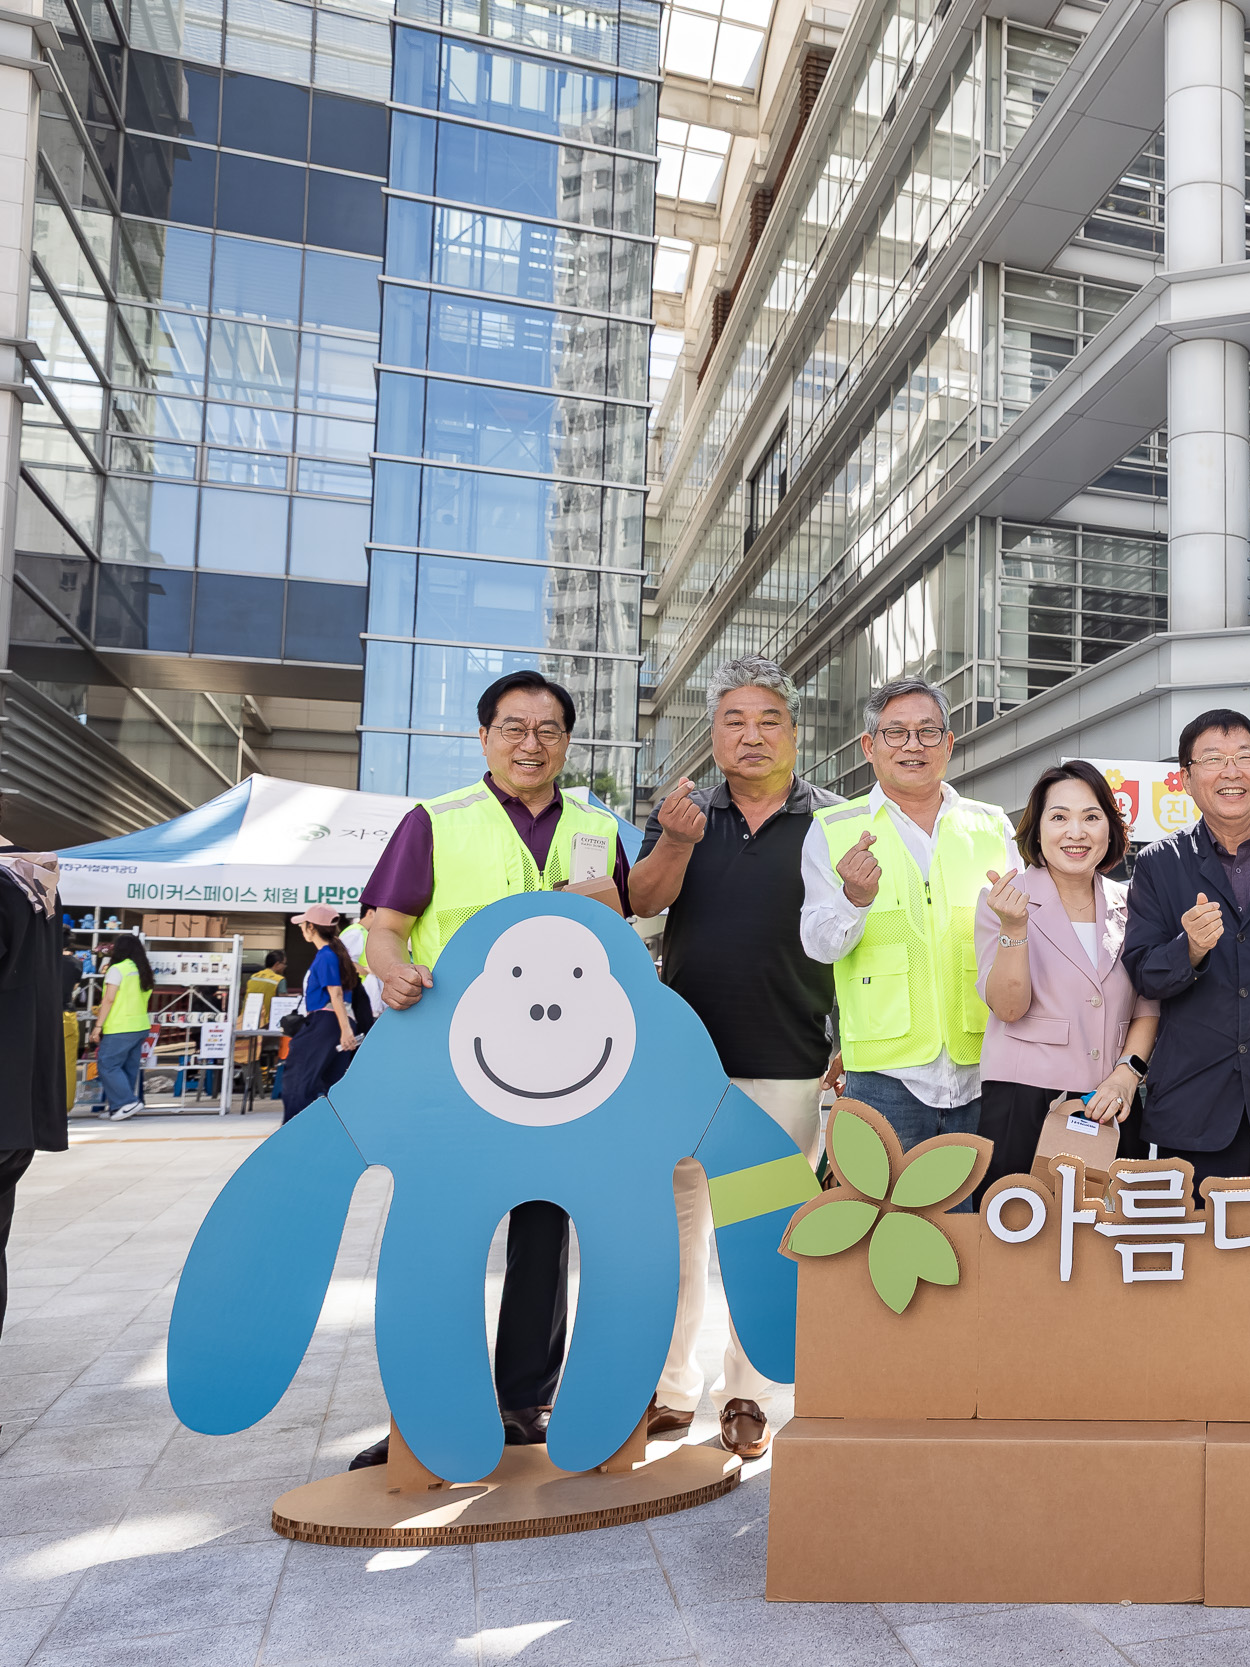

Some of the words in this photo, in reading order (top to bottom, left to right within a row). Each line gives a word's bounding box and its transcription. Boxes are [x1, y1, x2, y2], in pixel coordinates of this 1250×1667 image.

[1166, 799, 1188, 823] 진
[59, 863, 138, 875] 진구시설관리공단
[127, 882, 258, 903] 메이커스페이스
[262, 887, 298, 905] 체험
